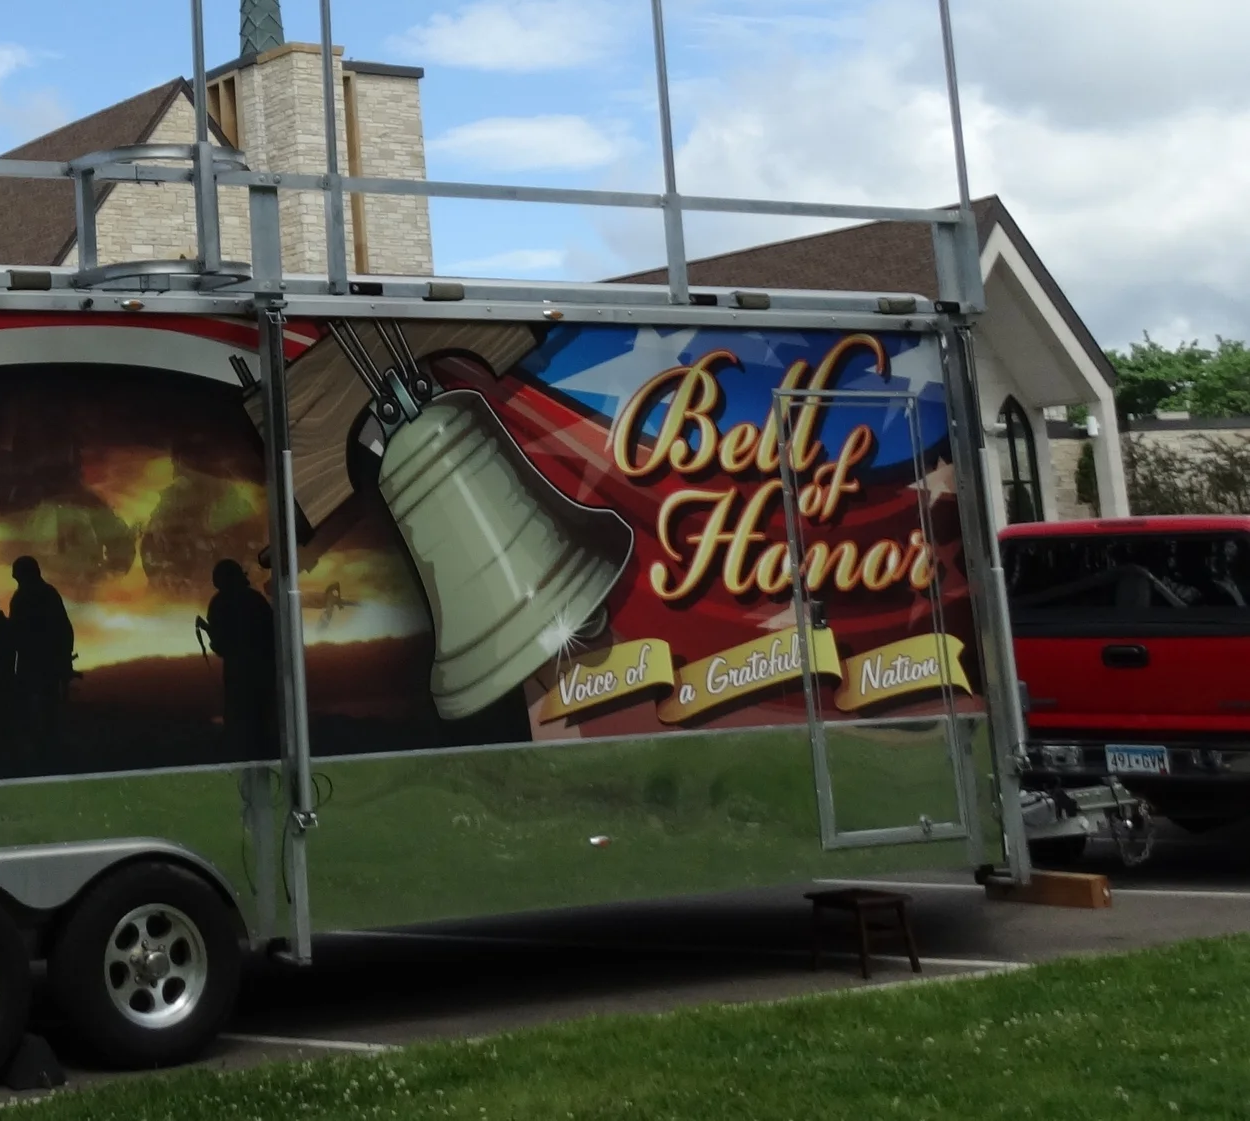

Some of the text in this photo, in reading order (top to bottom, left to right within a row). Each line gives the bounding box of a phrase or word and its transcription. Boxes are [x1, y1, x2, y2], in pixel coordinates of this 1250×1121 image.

[612, 333, 888, 477] Bell
[798, 423, 873, 520] of
[650, 479, 935, 601] Honor
[558, 632, 939, 706] Voice of a Grateful Nation
